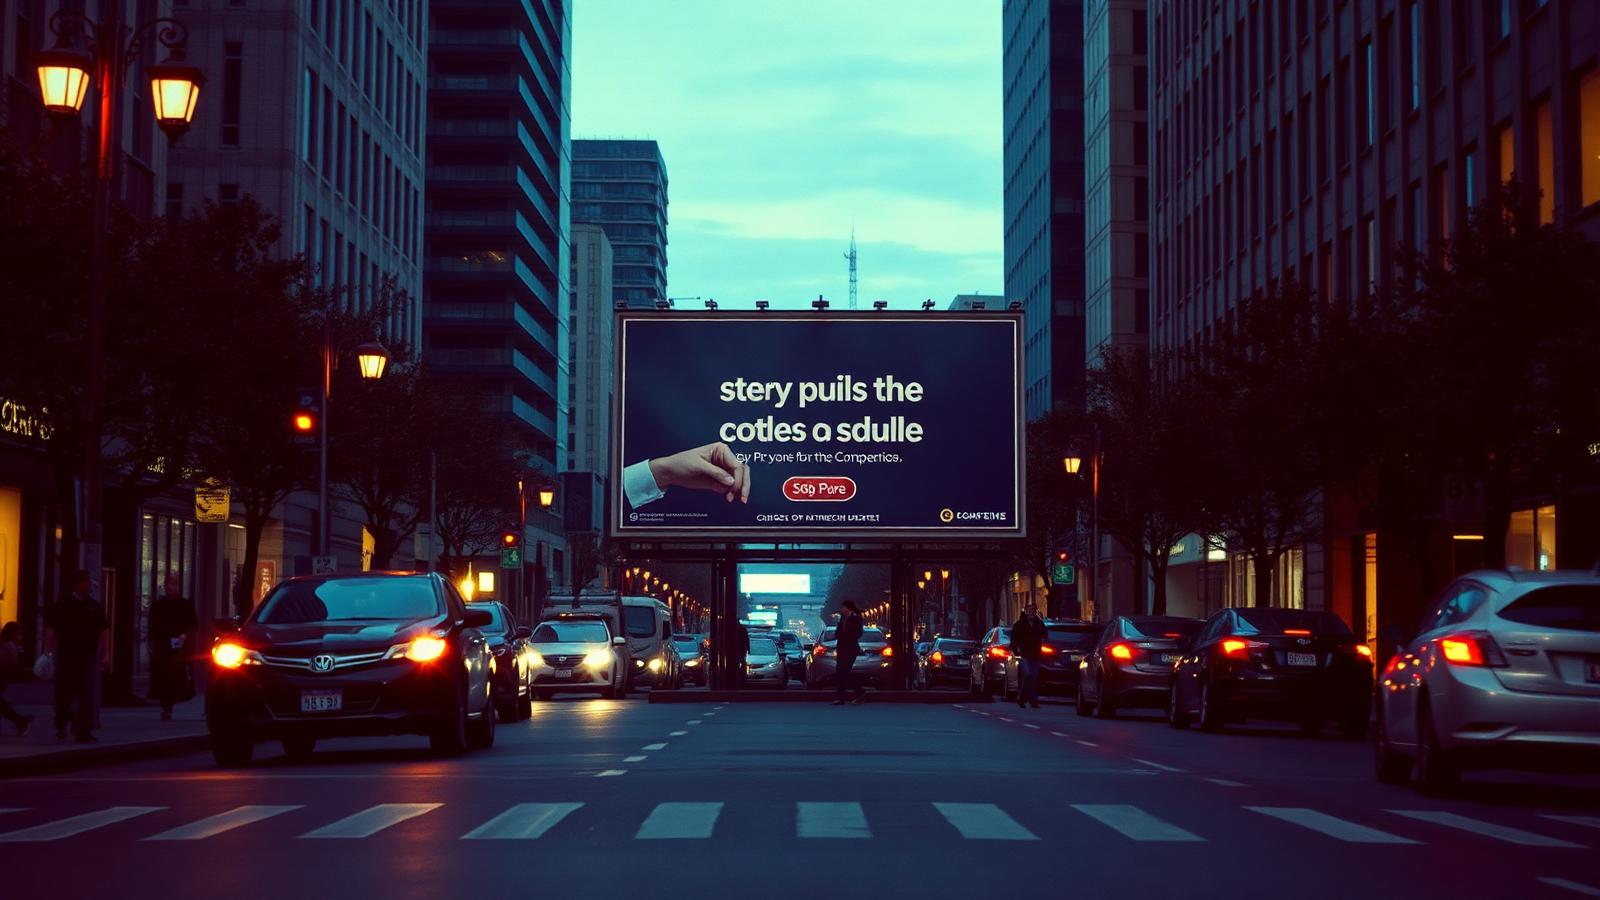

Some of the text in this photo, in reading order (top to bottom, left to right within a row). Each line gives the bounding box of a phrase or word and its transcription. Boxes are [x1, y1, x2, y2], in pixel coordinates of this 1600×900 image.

[720, 377, 793, 408] stery
[873, 375, 924, 402] the
[719, 416, 807, 442] cotles
[836, 416, 924, 442] sdulle
